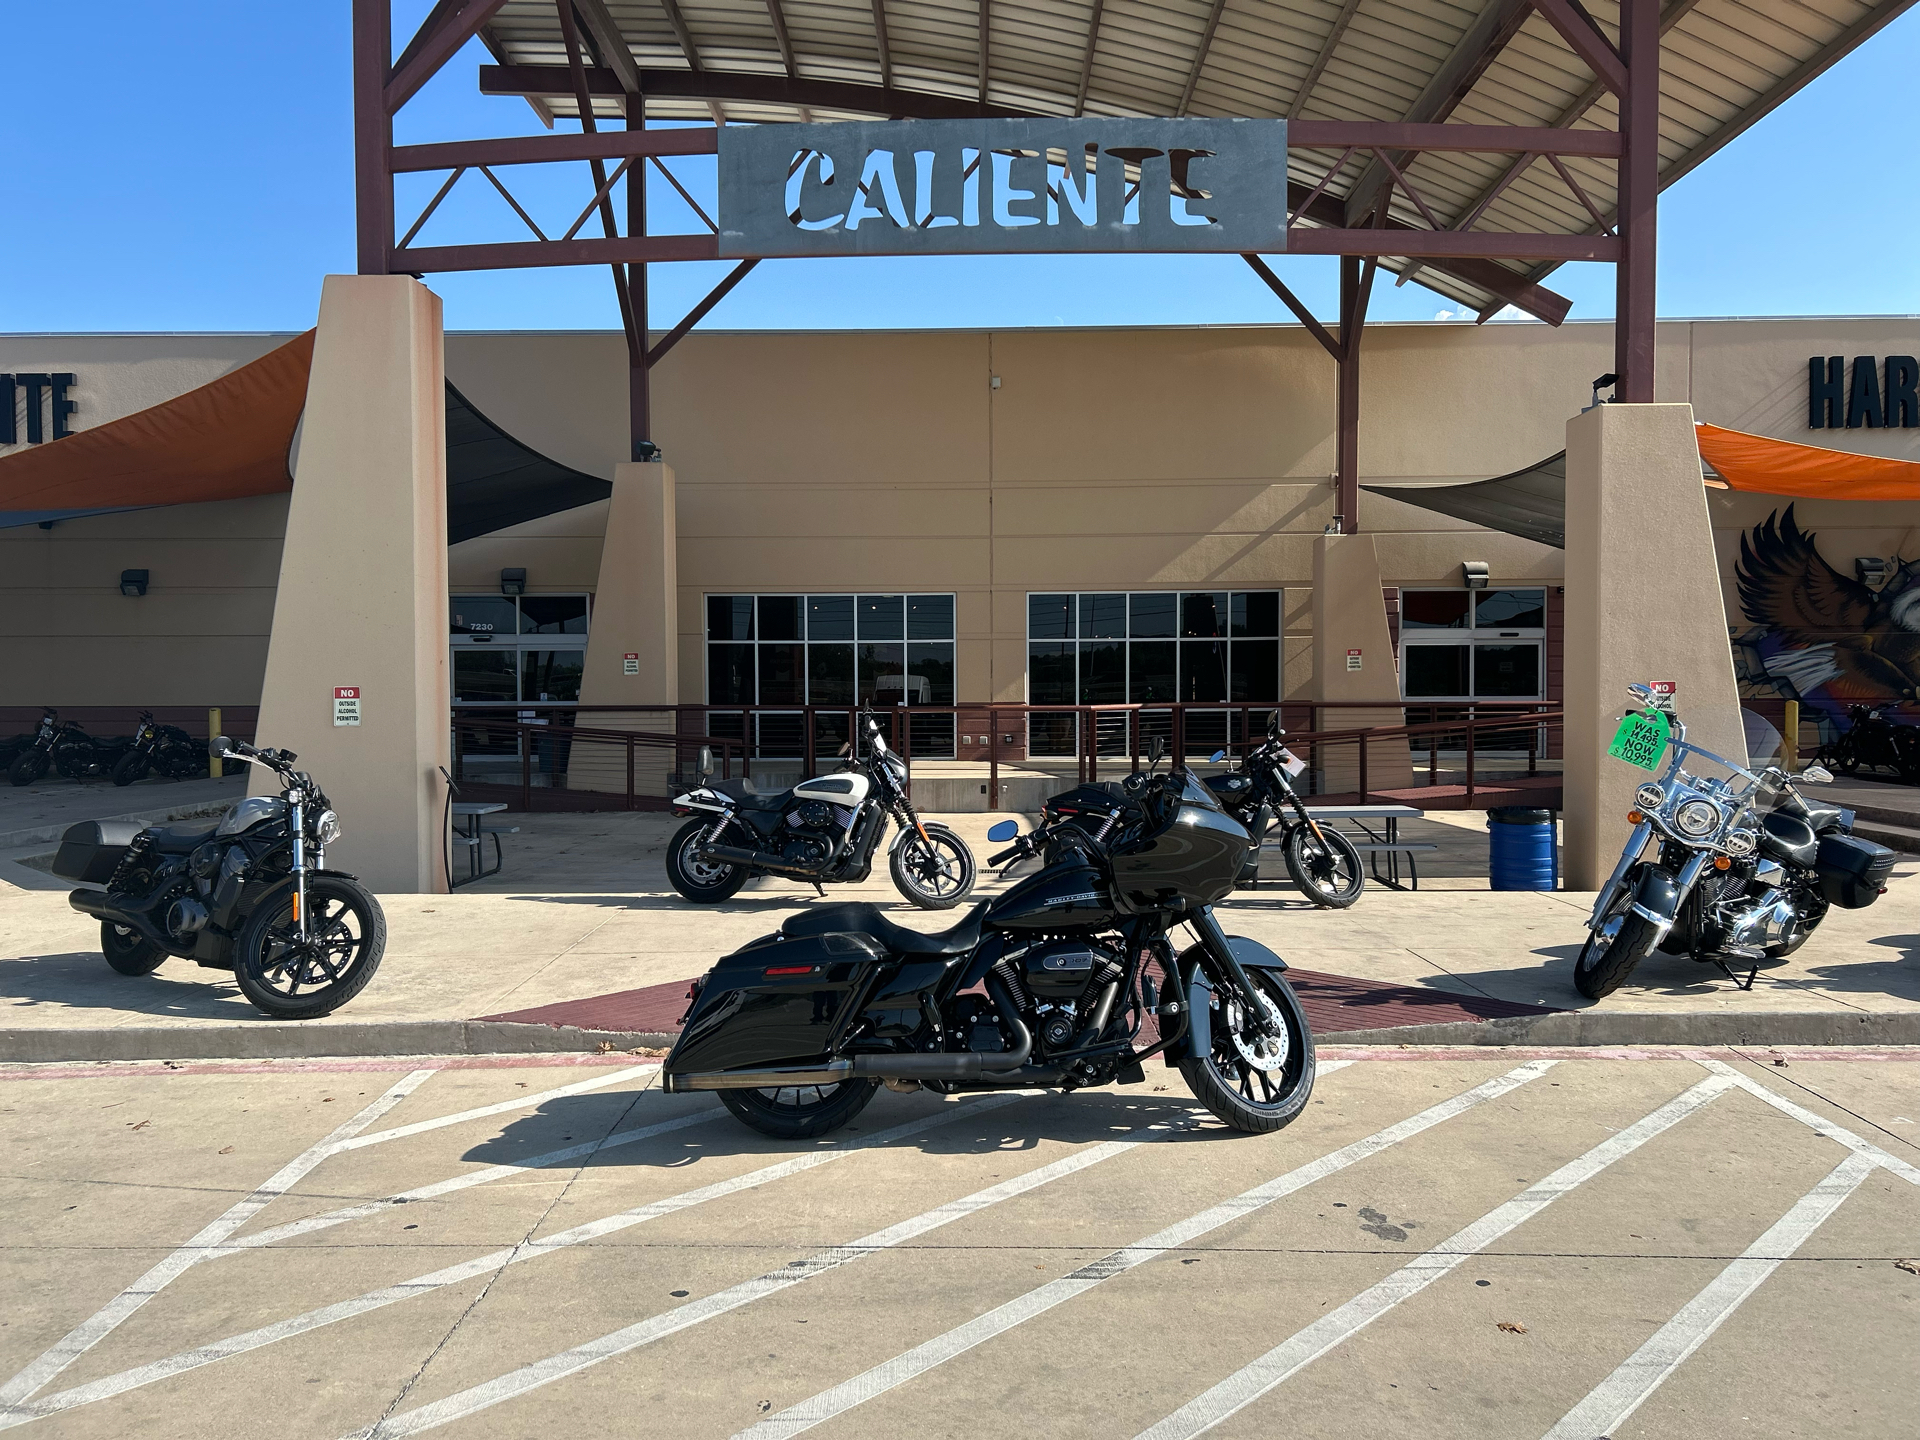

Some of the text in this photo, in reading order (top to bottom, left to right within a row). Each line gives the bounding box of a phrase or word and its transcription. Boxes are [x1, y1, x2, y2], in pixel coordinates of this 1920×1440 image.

[785, 142, 1217, 231] CALIENTE
[1808, 355, 1920, 429] HAR
[470, 623, 494, 631] 7230
[340, 689, 354, 697] NO
[1655, 684, 1669, 692] NO
[1635, 721, 1660, 737] WAS
[1624, 738, 1656, 756] NOW
